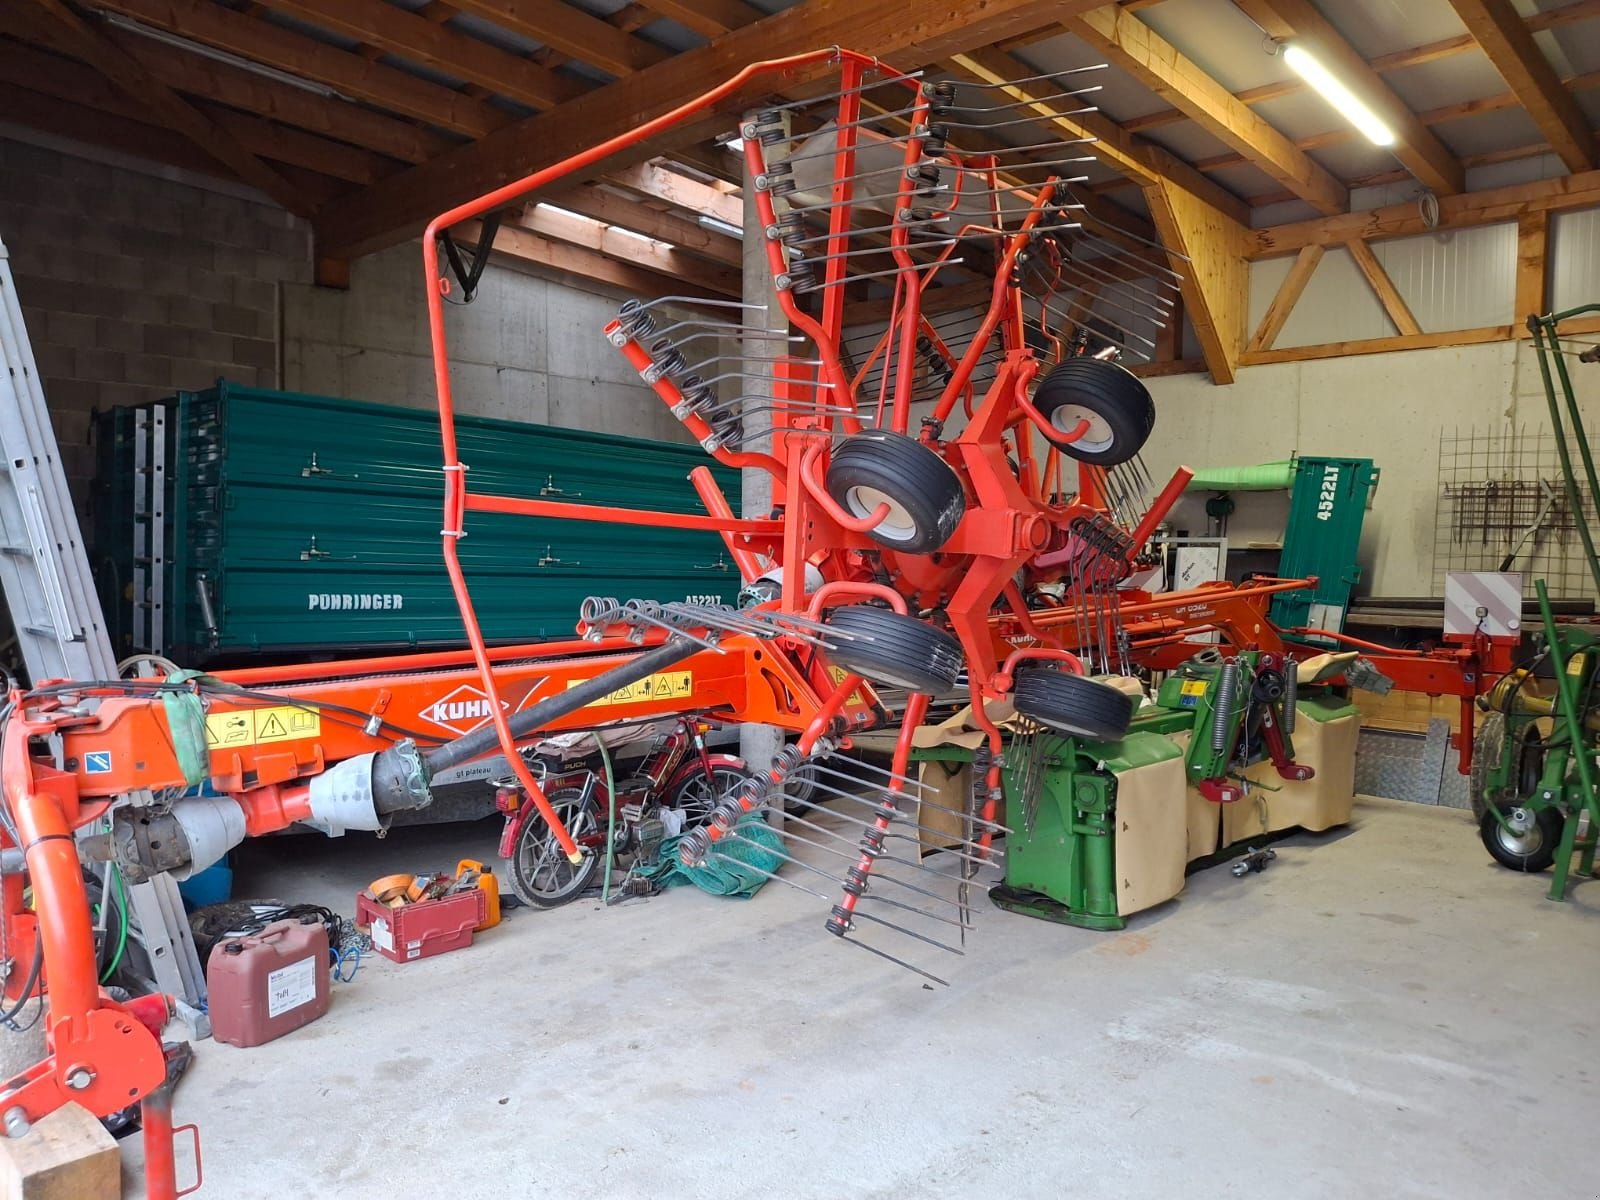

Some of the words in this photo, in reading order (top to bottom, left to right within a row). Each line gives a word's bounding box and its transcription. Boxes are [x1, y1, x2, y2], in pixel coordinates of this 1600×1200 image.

[1317, 465, 1339, 521] 4522LT
[564, 761, 587, 769] PUCH
[465, 767, 492, 777] plateau
